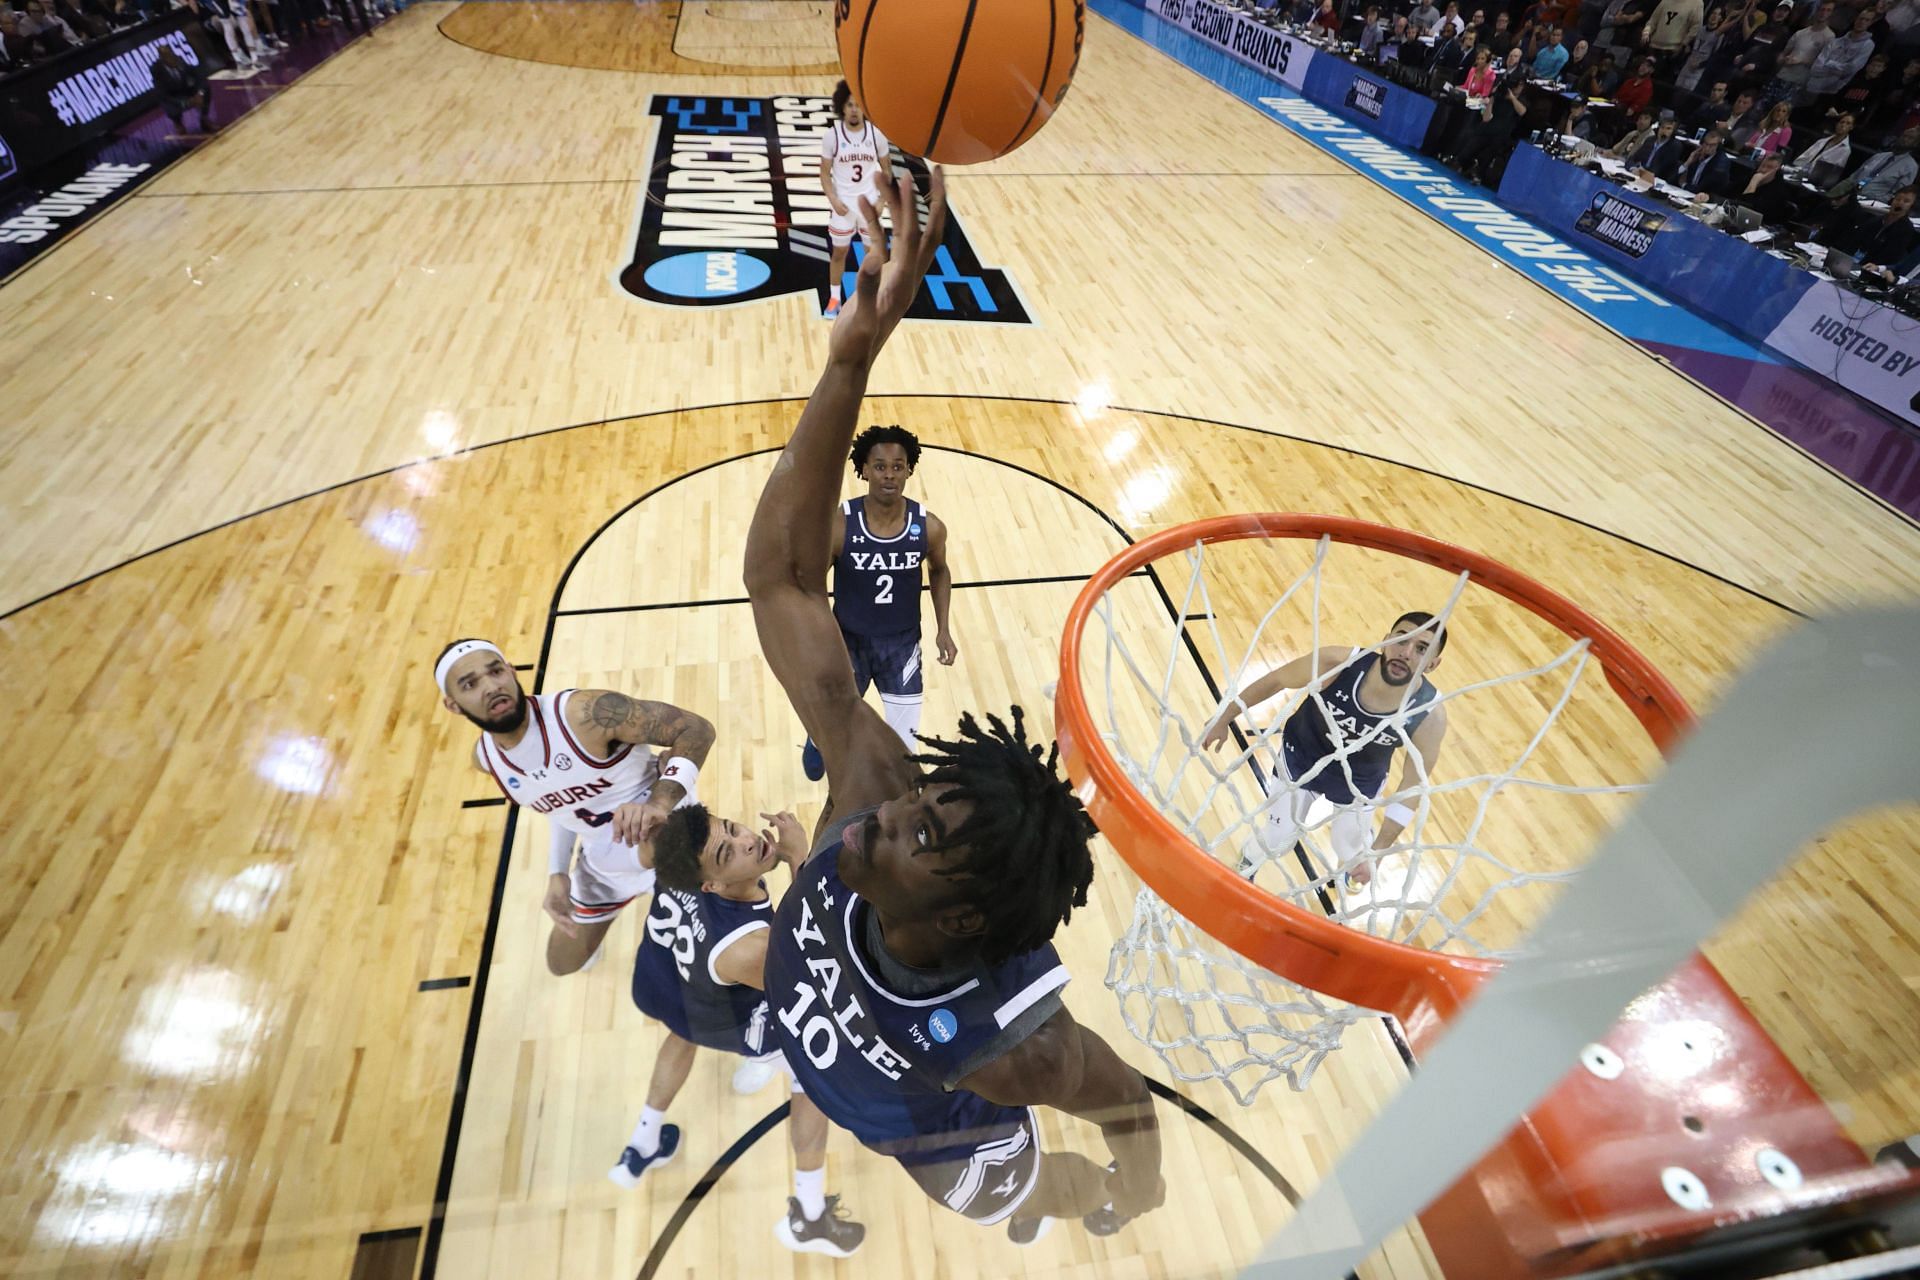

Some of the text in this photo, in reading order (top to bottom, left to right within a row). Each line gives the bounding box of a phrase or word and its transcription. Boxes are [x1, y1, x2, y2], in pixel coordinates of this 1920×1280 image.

[1665, 12, 1678, 24] Y
[1191, 0, 1233, 46] SECOND
[1233, 19, 1292, 75] ROUNDS
[1354, 93, 1383, 117] MADNESS
[1356, 79, 1378, 98] MARCH
[839, 152, 875, 163] AUBURN
[1257, 96, 1452, 184] FINAL FOUR
[658, 135, 779, 249] MARCH
[851, 164, 863, 183] 3
[0, 161, 152, 244] SPOKANE
[1600, 198, 1645, 229] MARCH
[1428, 196, 1636, 303] THE ROAD
[1596, 216, 1653, 254] MADNESS
[705, 252, 737, 291] NCAA
[1810, 314, 1920, 377] HOSTED BY
[850, 551, 921, 571] YALE
[874, 574, 894, 604] 2
[1327, 701, 1398, 746] YALE
[647, 892, 695, 983] 22
[792, 897, 913, 1083] YALE
[777, 981, 839, 1071] 10
[908, 1023, 925, 1043] Ivy
[930, 1015, 952, 1042] NCAA
